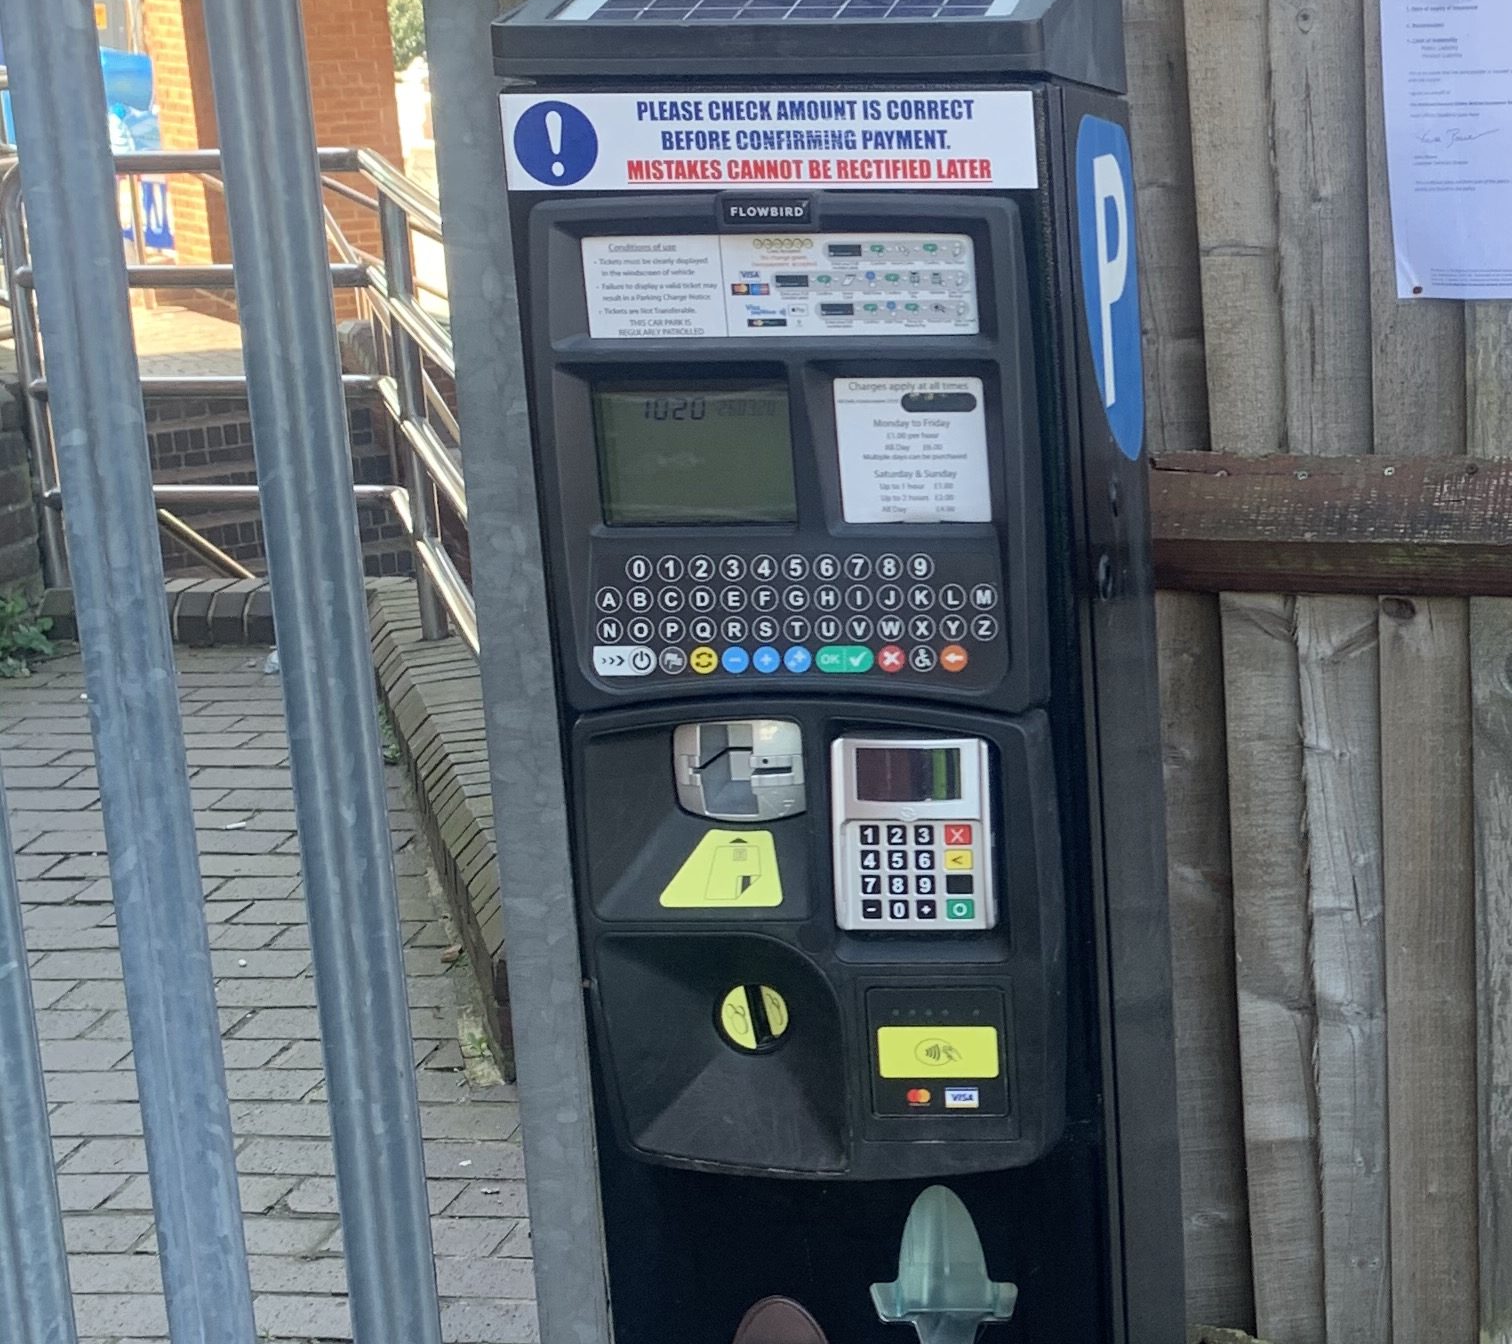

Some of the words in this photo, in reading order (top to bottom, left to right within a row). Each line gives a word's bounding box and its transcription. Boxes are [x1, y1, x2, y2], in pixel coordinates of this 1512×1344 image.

[636, 100, 705, 122] PLEASE
[707, 100, 773, 122] CHECK
[776, 99, 858, 121] AMOUNT
[862, 99, 882, 121] IS
[886, 99, 975, 121] CORRECT
[660, 129, 732, 151] BEFORE
[735, 129, 857, 151] CONFIRMING
[861, 129, 951, 150] PAYMENT.
[626, 159, 723, 181] MISTAKES
[726, 159, 804, 181] CANNOT
[807, 159, 833, 180] BE
[836, 158, 932, 180] RECTIFIED
[936, 158, 992, 180] LATER
[730, 206, 804, 217] FLOWBIRD
[849, 382, 887, 392] Charges
[889, 382, 915, 392] apply
[929, 382, 940, 390] all
[942, 382, 968, 390] times
[645, 398, 705, 420] 1020
[873, 419, 910, 429] Monday
[923, 419, 950, 428] Friday
[632, 559, 646, 578] 0
[664, 559, 675, 578] 1
[695, 559, 708, 578] 2
[726, 559, 740, 578] 3
[757, 559, 772, 577] 4
[789, 558, 802, 577] 5
[820, 558, 834, 577] 6
[851, 558, 865, 577] 7
[883, 558, 896, 576] 8
[914, 557, 927, 576] 9
[602, 592, 617, 608] A
[633, 591, 647, 607] B
[664, 591, 678, 607] C
[695, 591, 710, 607] D
[727, 591, 741, 607] E
[759, 591, 771, 606] F
[788, 590, 804, 606] G
[820, 590, 835, 606] H
[856, 590, 862, 606] I
[884, 590, 896, 606] J
[914, 589, 929, 605] K
[947, 589, 960, 605] L
[976, 589, 992, 605] M
[603, 622, 617, 638] N
[633, 622, 649, 638] O
[666, 622, 679, 638] P
[695, 622, 711, 638] Q
[728, 622, 742, 637] R
[759, 621, 773, 637] S
[790, 621, 804, 637] T
[821, 621, 835, 637] U
[852, 621, 867, 636] V
[880, 621, 901, 636] W
[915, 620, 929, 636] X
[946, 620, 960, 636] Y
[978, 620, 992, 636] Z
[821, 654, 840, 665] OK
[863, 827, 873, 844] 1
[890, 827, 903, 843] 2
[918, 827, 930, 843] 3
[863, 852, 877, 869] 4
[891, 852, 904, 869] 5
[918, 852, 931, 869] 6
[864, 877, 877, 893] 7
[891, 877, 904, 893] 8
[919, 877, 932, 893] 9
[893, 902, 905, 918] 0
